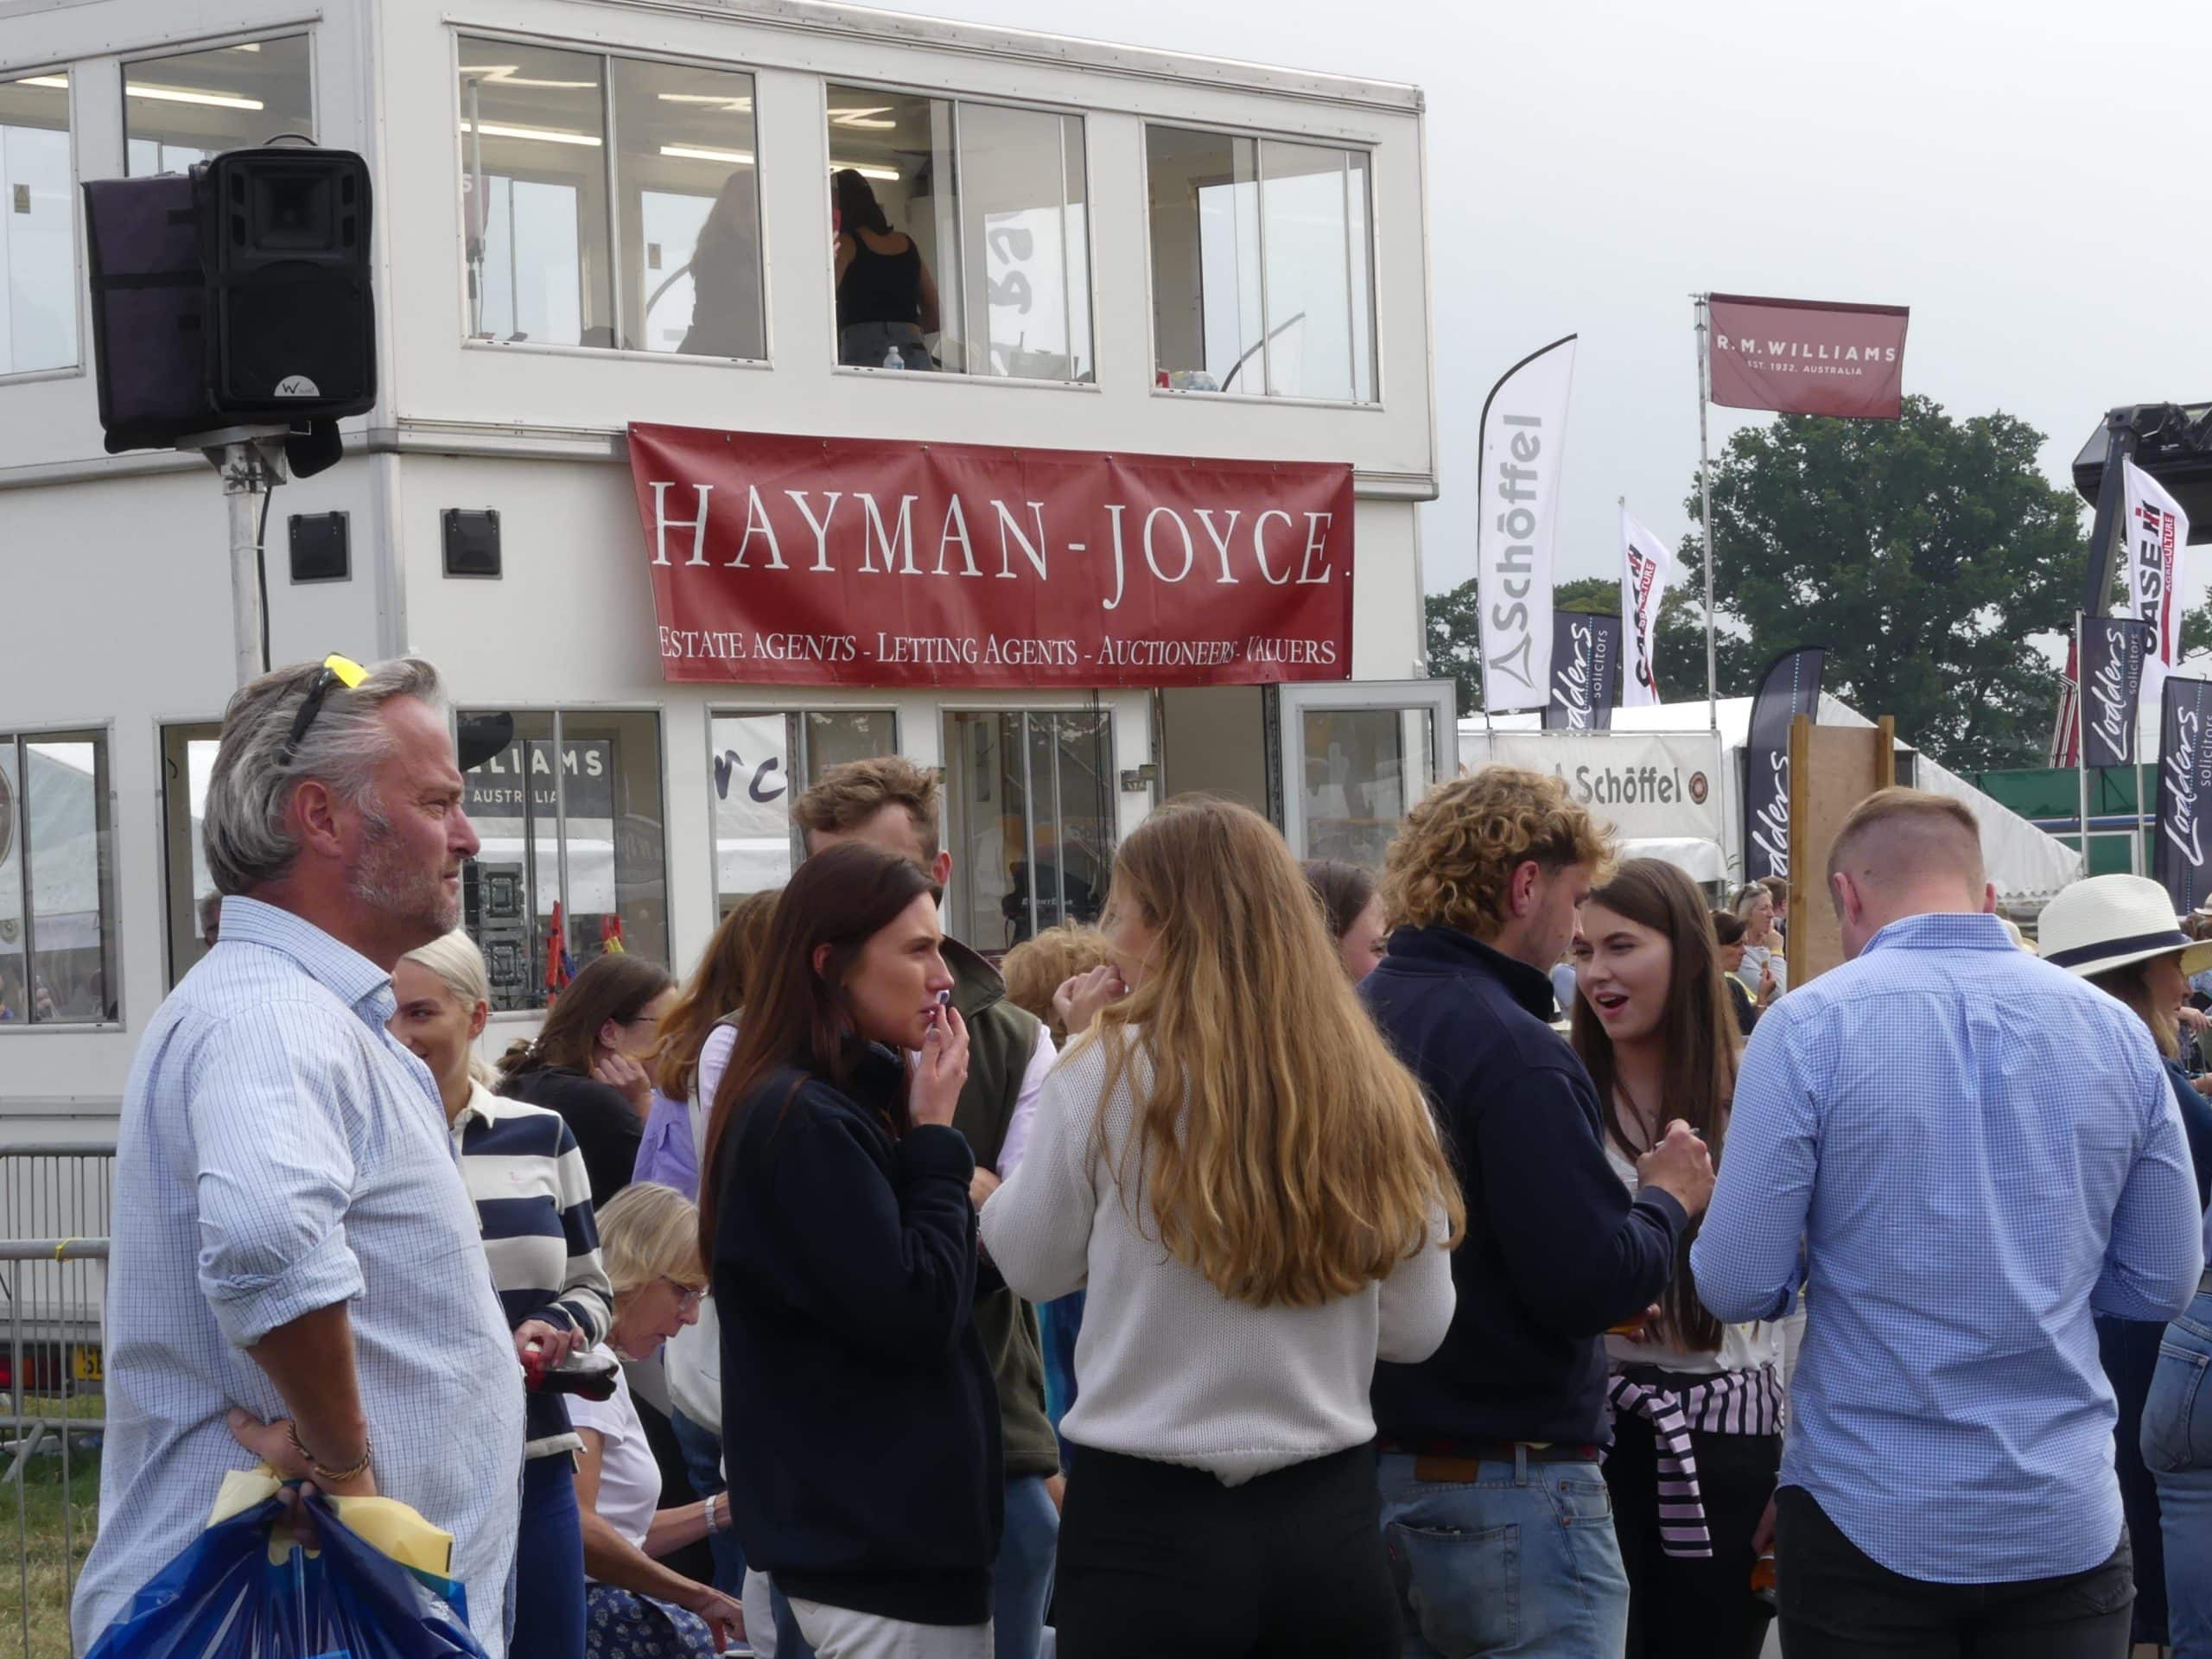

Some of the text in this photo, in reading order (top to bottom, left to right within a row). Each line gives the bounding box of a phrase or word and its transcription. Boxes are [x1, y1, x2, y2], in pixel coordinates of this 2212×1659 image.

[1802, 365, 1862, 376] AUSTRALIA
[1492, 414, 1542, 632] Schöffel
[2163, 516, 2175, 592] AGRICULTURE
[658, 626, 747, 658] ESTATE
[753, 632, 857, 662] AGENTS
[877, 632, 978, 664] LETTING
[983, 633, 1077, 665] AGENTS
[1246, 635, 1337, 664] VALUERS
[1552, 622, 1592, 731] dders
[1592, 629, 1609, 699] solicitors
[2127, 632, 2140, 695] solicitors
[2091, 628, 2127, 761] Lodders
[473, 789, 557, 804] AUSTRLIA
[1575, 765, 1681, 804] Schöffel
[1752, 751, 1789, 878] dders
[2164, 706, 2204, 867] Lodders
